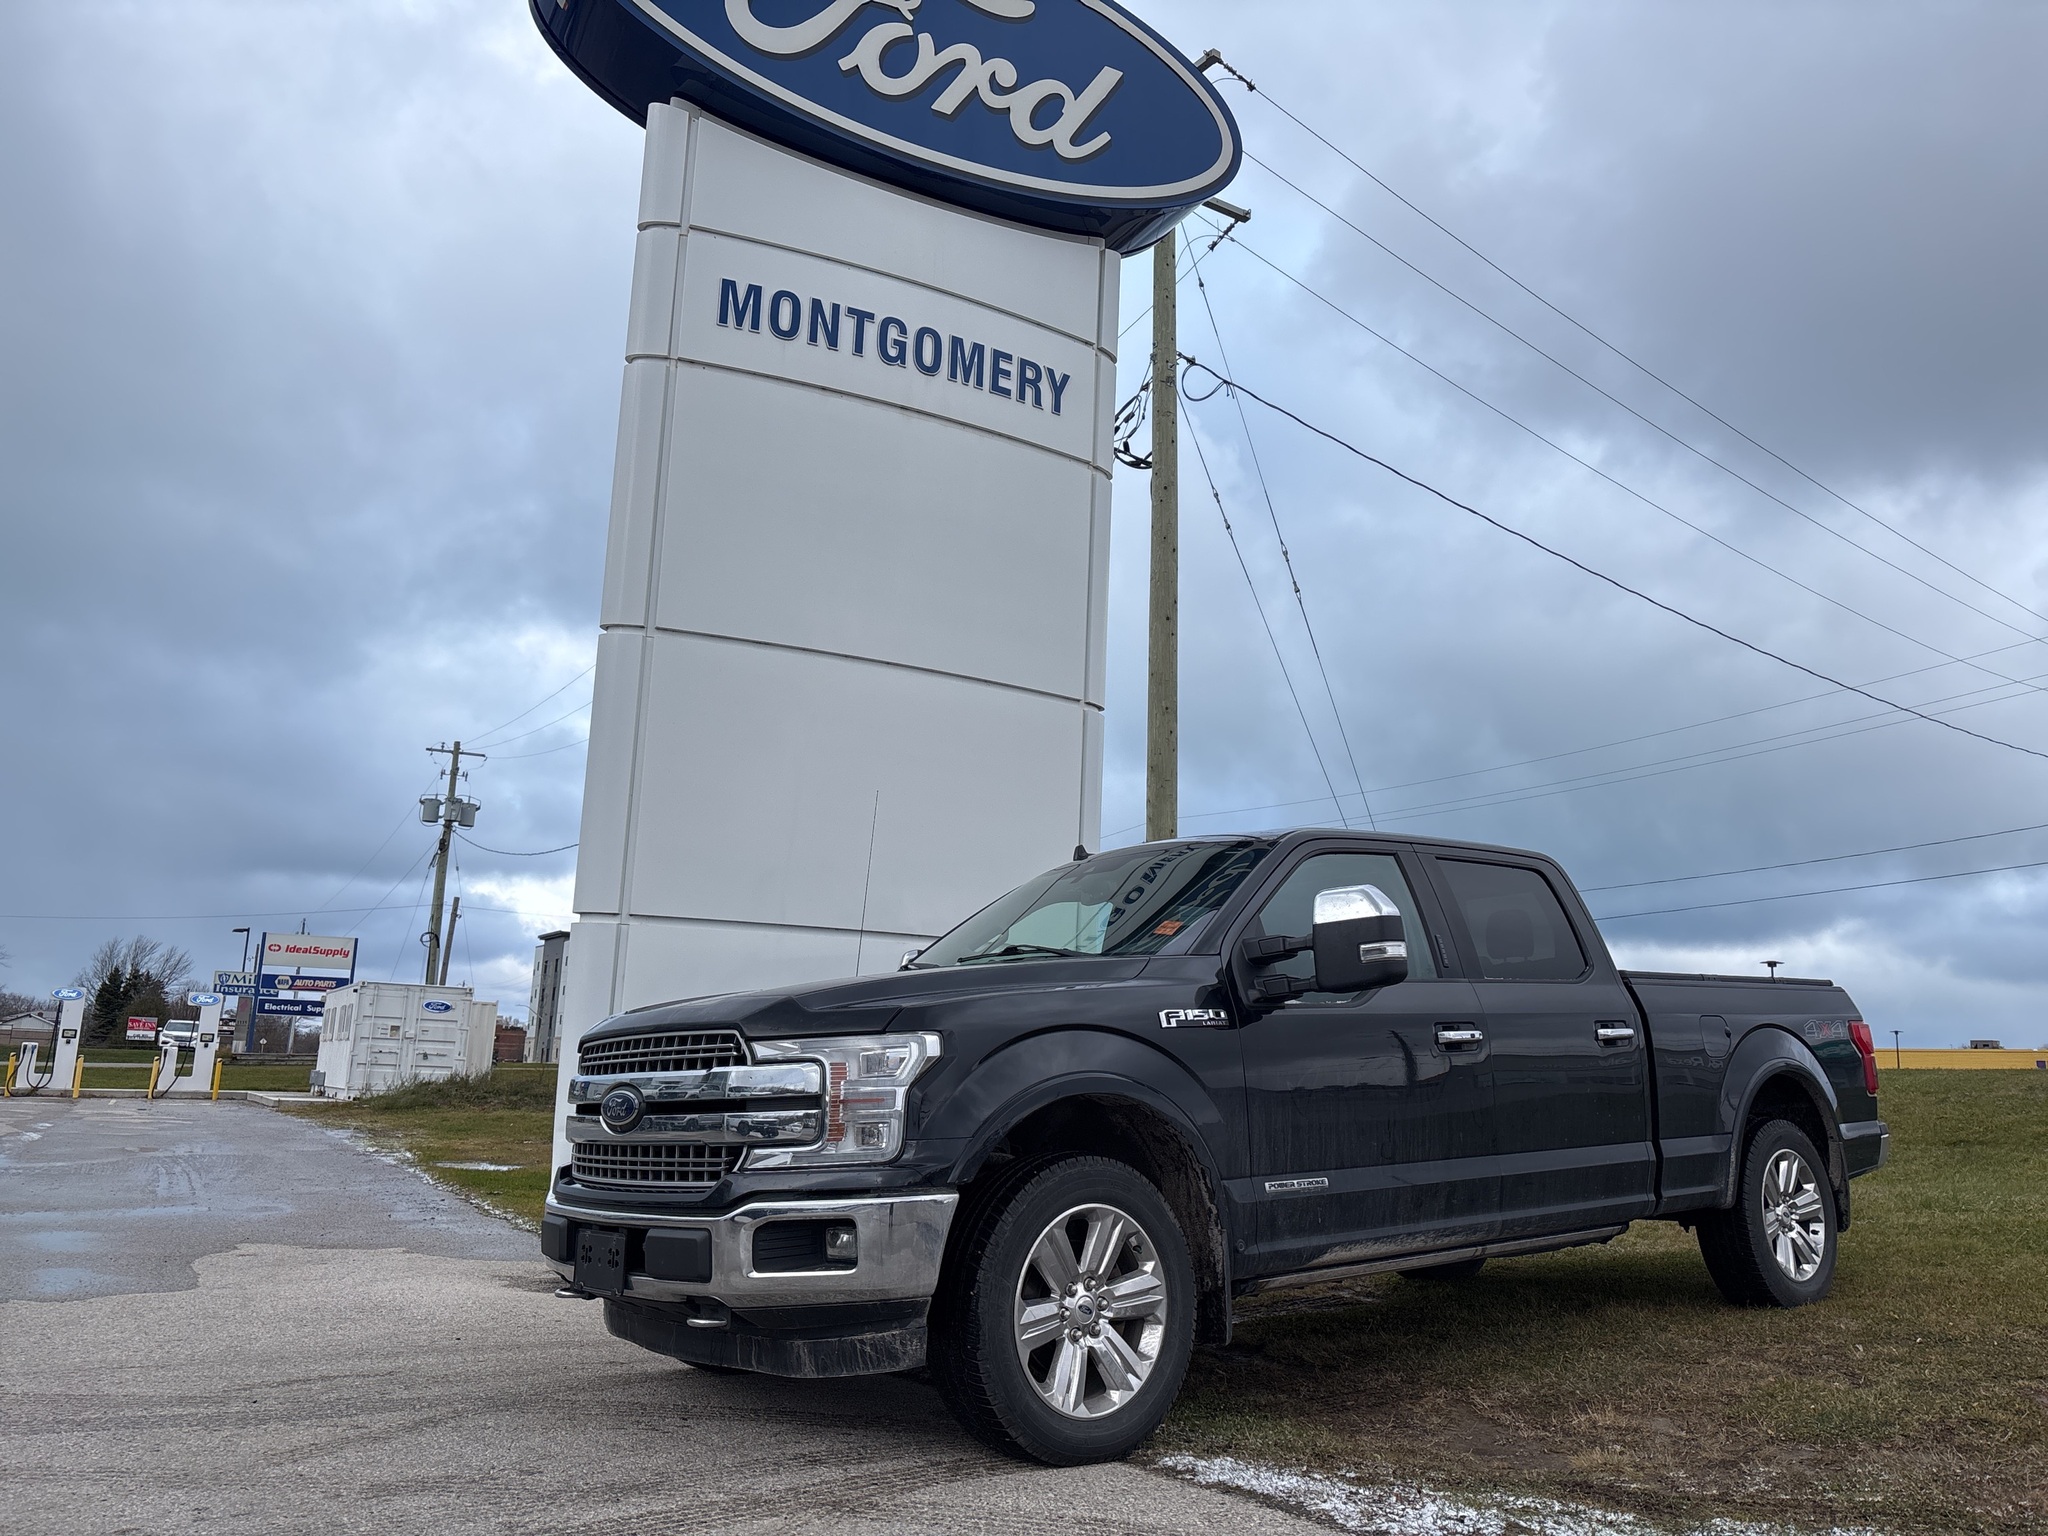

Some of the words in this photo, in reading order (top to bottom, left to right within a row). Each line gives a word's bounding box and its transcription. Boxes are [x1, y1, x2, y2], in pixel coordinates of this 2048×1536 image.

[717, 277, 1071, 415] MONTGOMERY
[285, 944, 351, 959] IdealSupply
[276, 978, 290, 987] NAPA
[293, 979, 314, 987] AUTO
[314, 980, 337, 988] PARTS
[215, 984, 278, 996] Insurace
[264, 1002, 302, 1012] Electrical
[606, 1097, 628, 1117] Ford
[1267, 1181, 1295, 1190] POWER
[1296, 1178, 1327, 1189] STROKE
